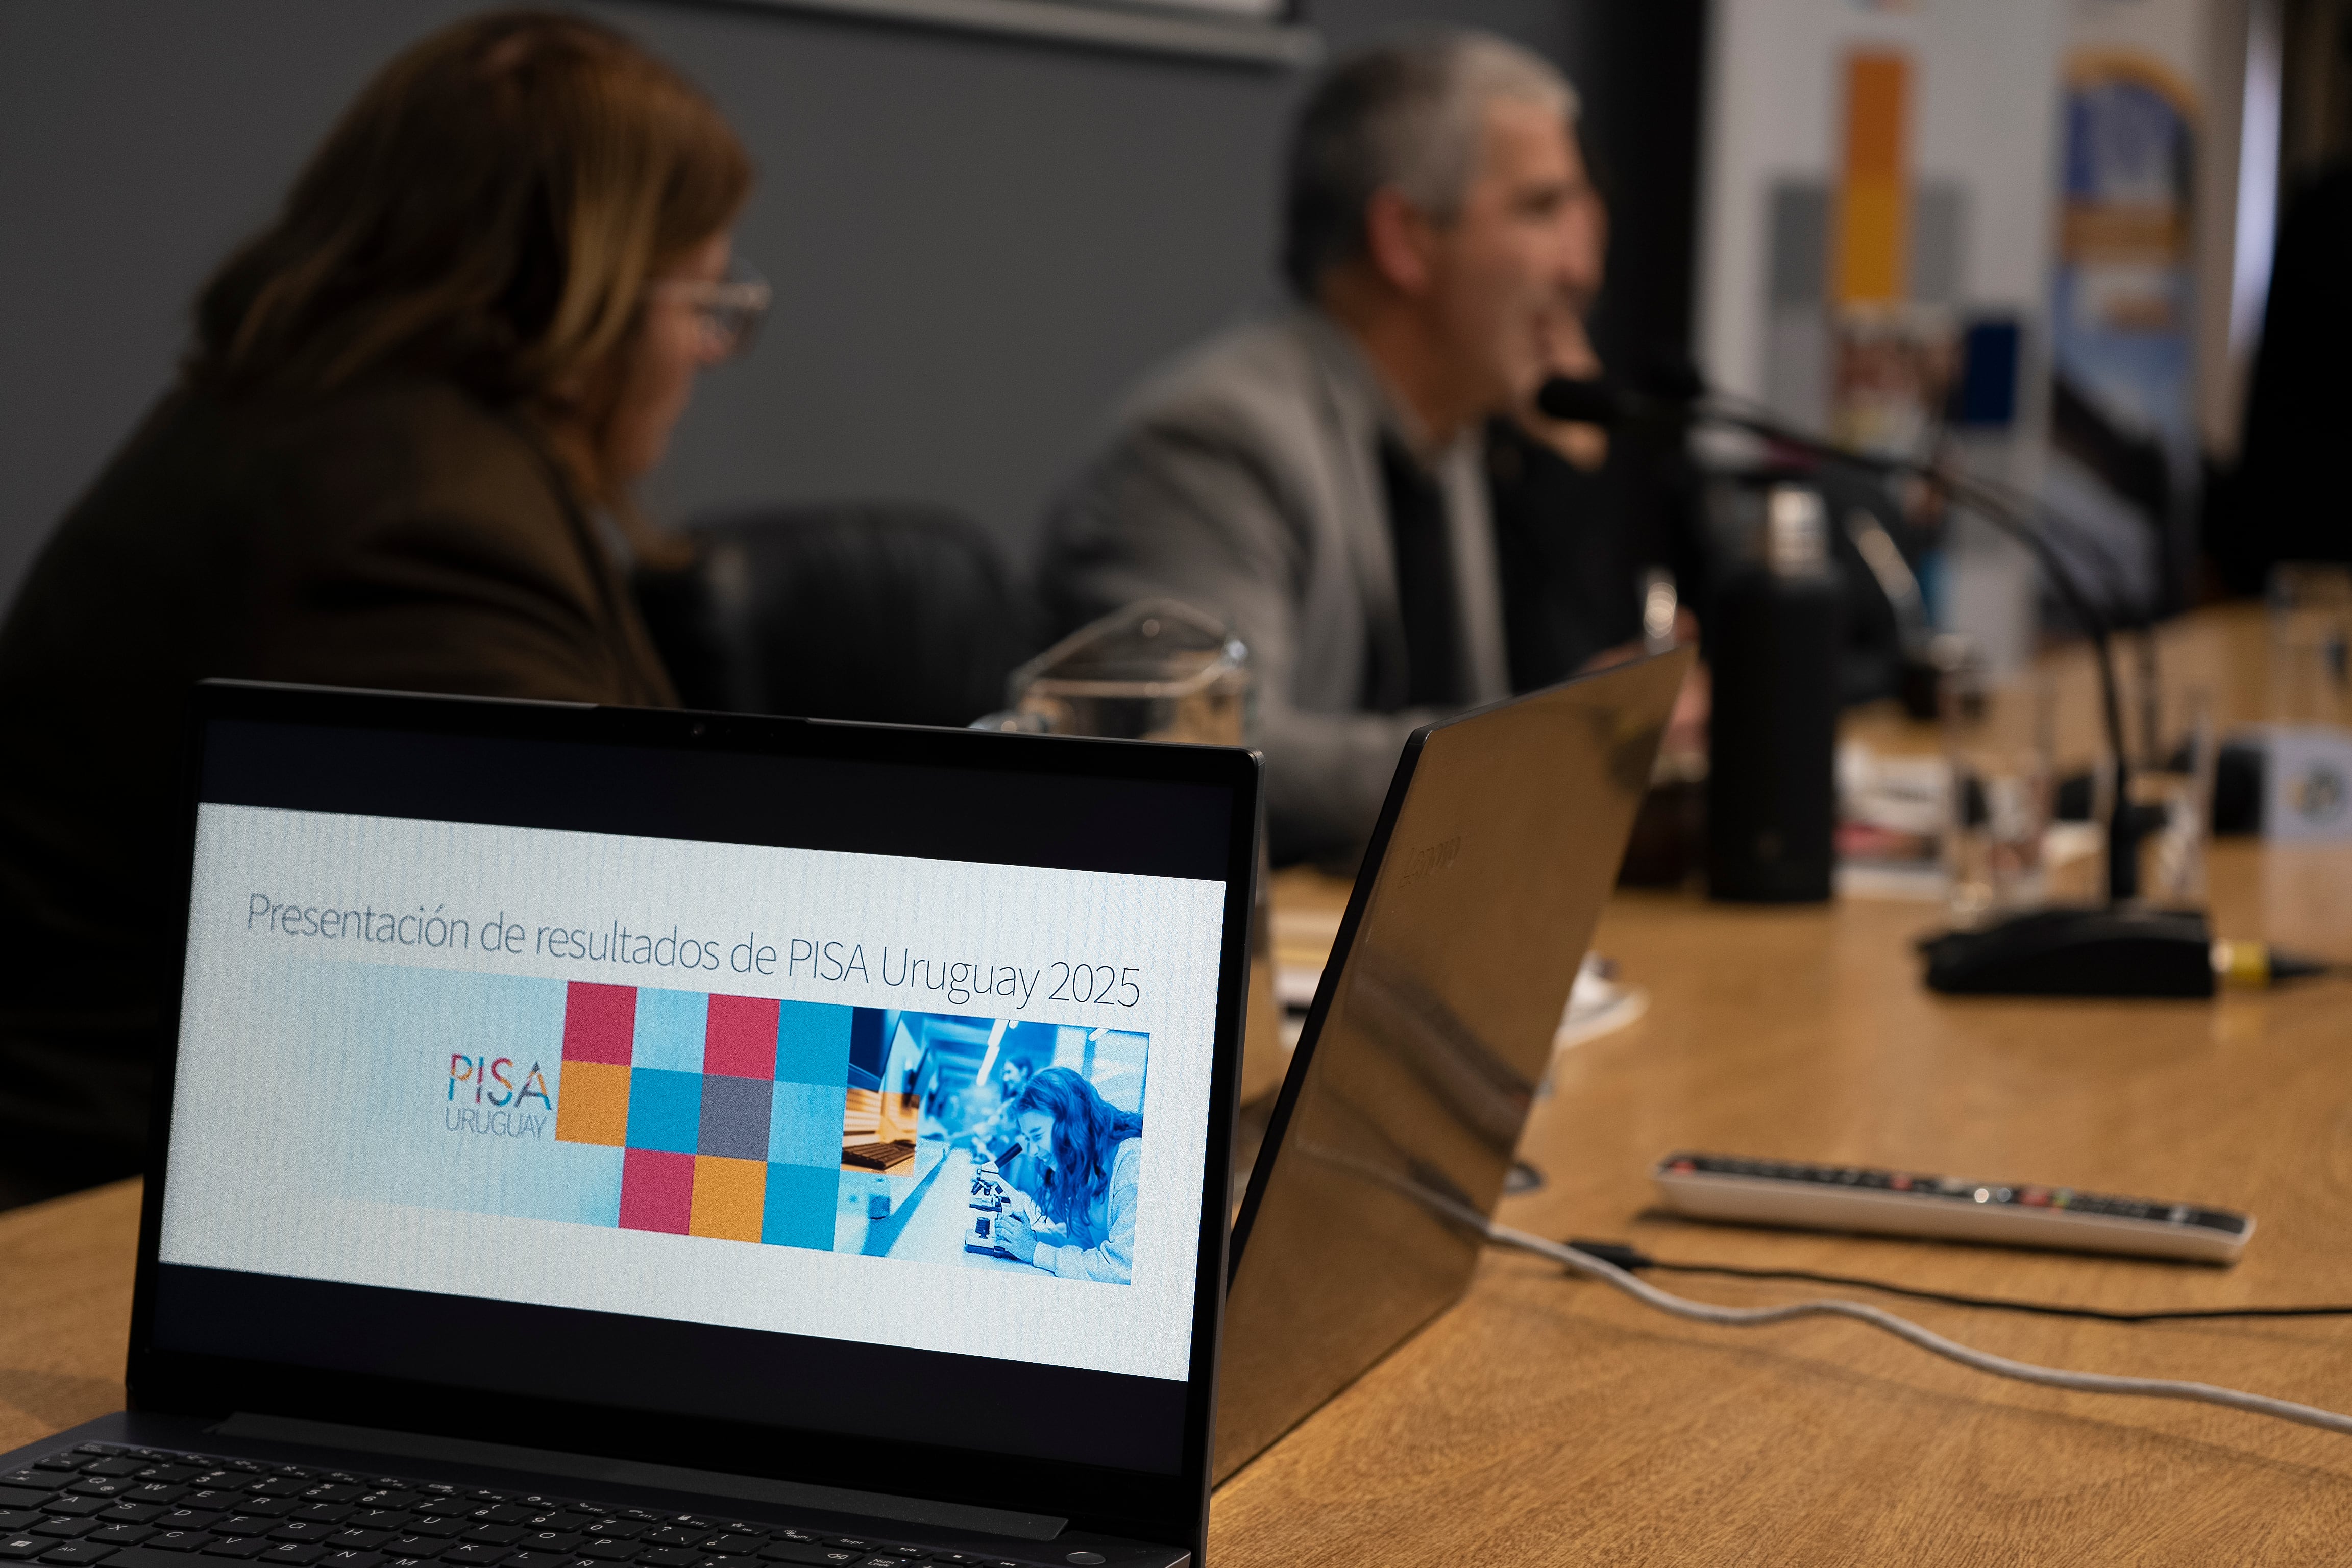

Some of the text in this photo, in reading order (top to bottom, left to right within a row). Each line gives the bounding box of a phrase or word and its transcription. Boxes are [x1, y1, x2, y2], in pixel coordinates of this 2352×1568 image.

[247, 892, 1140, 1009] Presentación de resultados de PISA Uruguay 2025
[448, 1053, 552, 1111] PISA
[446, 1107, 548, 1139] URUGUAY
